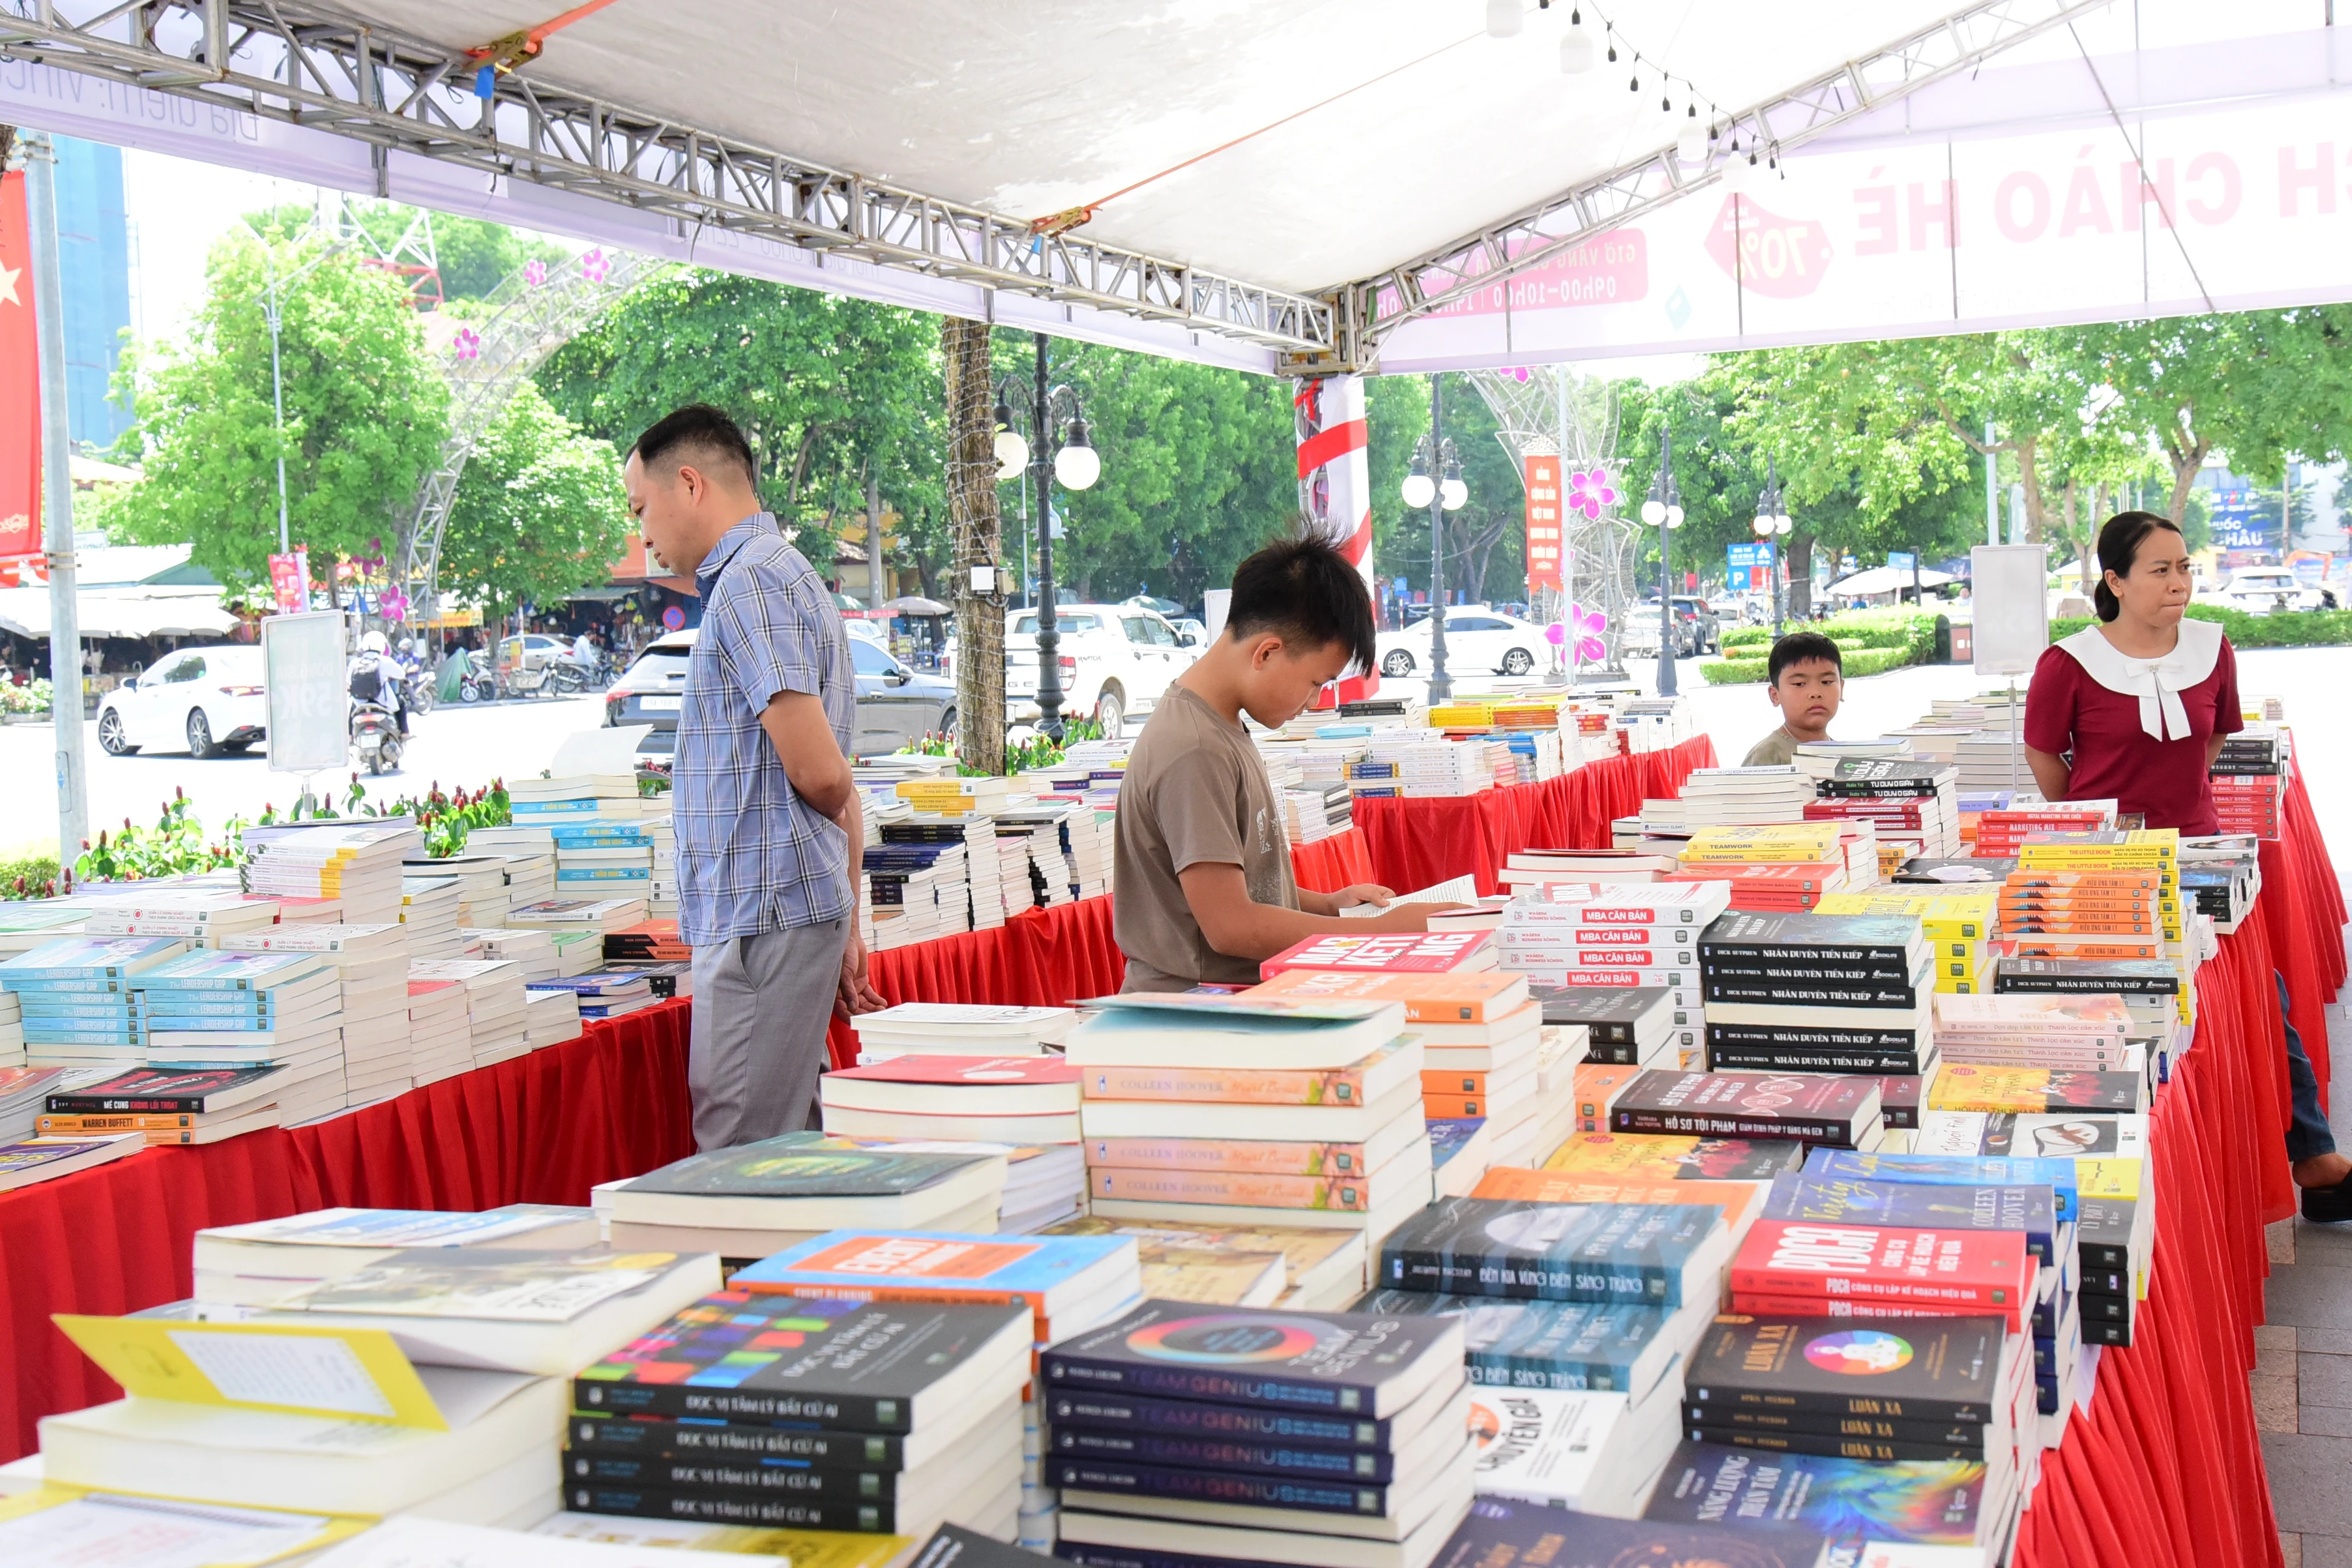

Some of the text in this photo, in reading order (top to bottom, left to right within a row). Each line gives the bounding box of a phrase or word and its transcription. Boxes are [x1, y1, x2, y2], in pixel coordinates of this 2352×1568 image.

[1733, 572, 1744, 586] P
[1587, 909, 1646, 920] MBA CĂN BẢN
[1580, 930, 1641, 941] MBA CĂN BẢN
[1584, 951, 1644, 962] MBA CĂN BẢN
[1763, 949, 1788, 958] NHÂN
[1790, 949, 1818, 959] DUYÊN
[1820, 949, 1840, 959] TIỀN
[1843, 950, 1862, 959] KIẾP
[46, 969, 81, 978] LEADERSHIP
[54, 982, 85, 991] LEADERSHIP
[86, 982, 97, 991] GAP
[182, 979, 213, 988] LEADERSHIP
[215, 979, 225, 988] GAP
[1120, 1080, 1223, 1092] COLLEEN HOOVER
[82, 1118, 144, 1128] WARREN BUFFETT 10
[1665, 1115, 1678, 1130] HỒ
[1695, 1118, 1709, 1132] TỘI
[1711, 1119, 1736, 1134] PHẠM
[1826, 1278, 1850, 1294] PDCA
[1189, 1376, 1279, 1400] GENIUS
[1849, 1398, 1901, 1416] LUÂN XA
